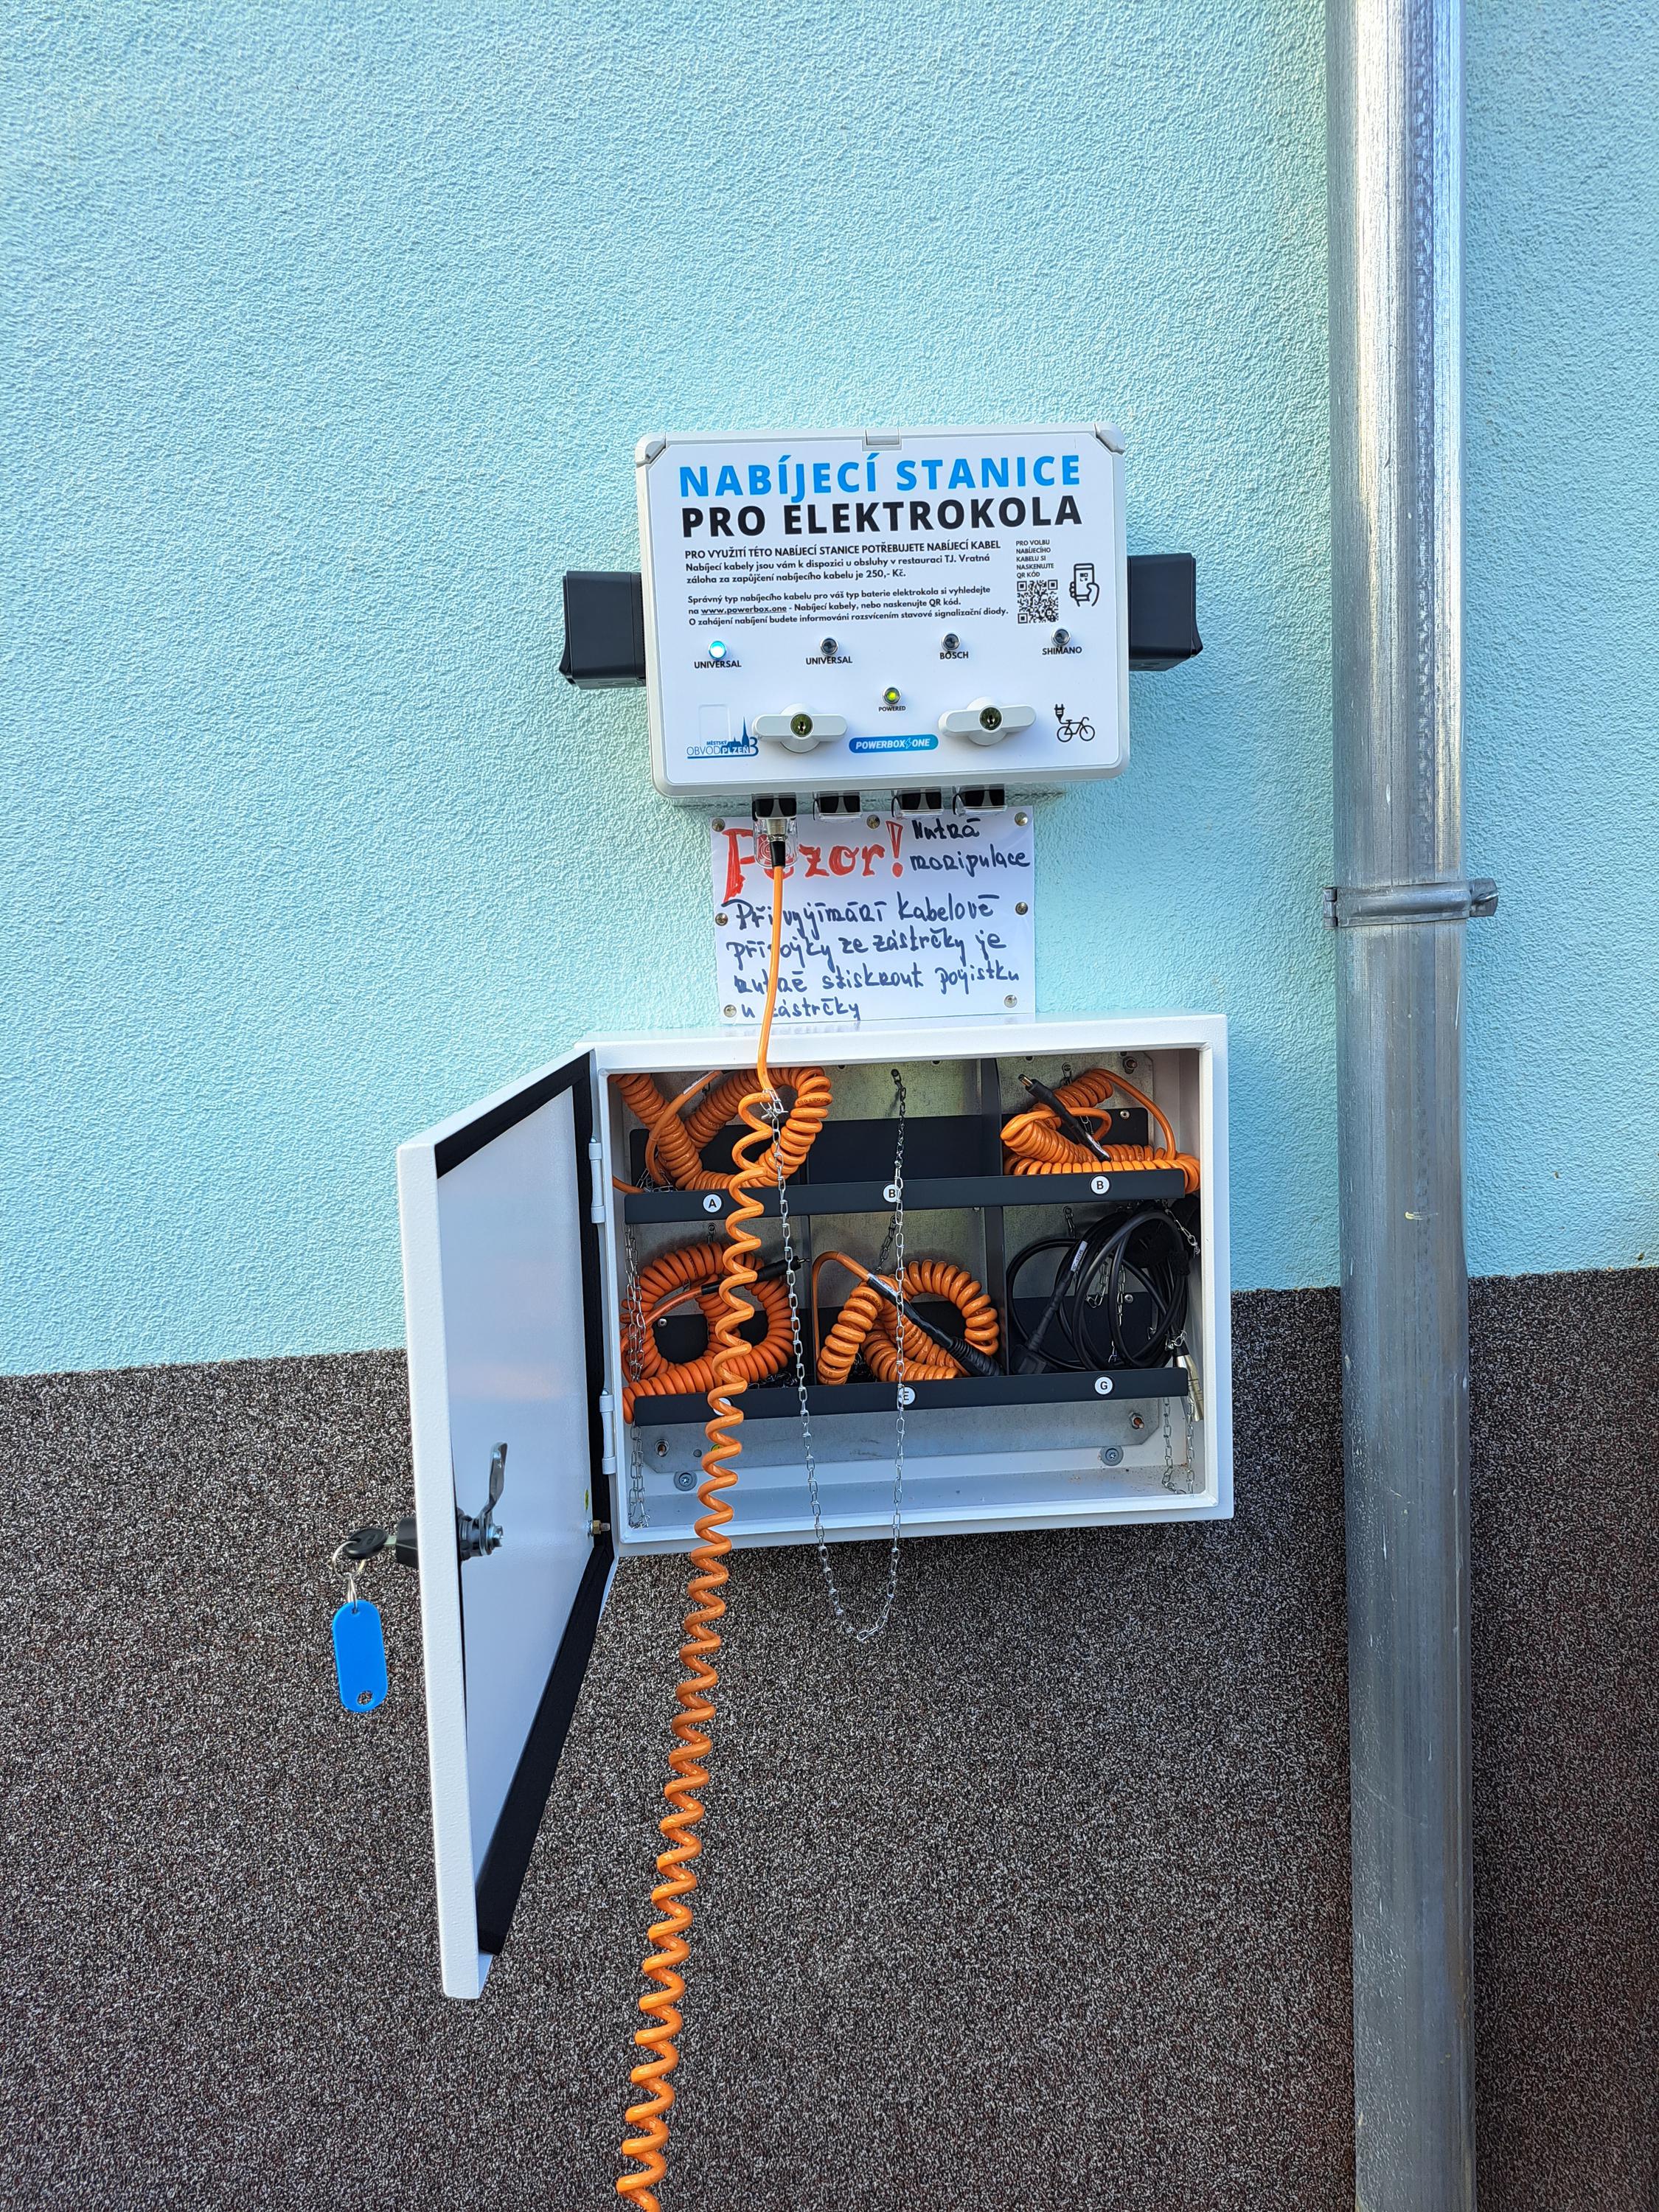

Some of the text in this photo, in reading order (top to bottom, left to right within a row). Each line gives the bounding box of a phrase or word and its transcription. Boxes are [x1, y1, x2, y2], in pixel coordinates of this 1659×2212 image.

[679, 453, 1080, 503] NABÍJECÍ STANICE
[682, 495, 1082, 538] PRO ELEKTROKOLA
[685, 540, 1001, 559] PRO VYUŽITÍ TÉTO NABÍJECÍ STANICE POTŘEBUJETE NABÍJECÍ KABEL
[686, 563, 722, 573] Nabíjecí
[724, 562, 754, 572] kabely
[756, 562, 774, 571] jsou
[776, 560, 796, 568] vám
[799, 560, 804, 568] k
[806, 559, 844, 569] dispozici
[854, 557, 888, 567] obsluhy
[898, 556, 942, 565] restauraci
[959, 554, 990, 563] Vratná
[686, 575, 717, 584] záloha
[732, 574, 774, 585] zapůjčení
[776, 572, 821, 582] nabíjecího
[824, 571, 854, 580] kabelu
[855, 571, 863, 580] je
[866, 570, 890, 580] 250,-
[892, 568, 906, 577] Kč.
[688, 596, 723, 605] Správný
[725, 596, 738, 604] typ
[740, 594, 782, 603] nabíjecího
[784, 592, 812, 601] kabelu
[813, 594, 828, 602] pro
[846, 591, 860, 600] typ
[861, 590, 890, 598] baterie
[892, 588, 939, 597] elektrokola
[949, 586, 990, 596] vyhledejte
[700, 605, 787, 615] www.powerbox.one
[794, 603, 827, 613] Nabíjecí
[830, 602, 859, 611] kabely,
[861, 601, 881, 609] nebo
[883, 599, 927, 608] naskenujte
[698, 617, 733, 627] zahájení
[735, 616, 768, 625] nabíjení
[769, 615, 797, 624] budete
[799, 613, 849, 622] informováni
[851, 611, 899, 620] rozsvícením
[901, 611, 933, 619] stavové
[934, 608, 981, 618] signalizační
[984, 608, 1009, 616] diody.
[939, 651, 969, 660] BOSCH
[1042, 646, 1082, 655] SHIMANO
[694, 660, 742, 669] UNIVERSAL
[806, 655, 852, 665] UNIVERSAL
[686, 746, 720, 756] OBVOD
[723, 745, 749, 754] PLZEŇ
[855, 738, 931, 750] POWERBOX ONE
[909, 844, 1031, 877] manipulace
[721, 898, 773, 930] Při
[897, 891, 1000, 922] kabelové
[726, 925, 1006, 973] příojky ze zástrčky je
[822, 961, 924, 990] stisknout
[935, 959, 1020, 995] pojistku
[741, 996, 861, 1021] u ástrčky
[1096, 1180, 1104, 1189] B
[888, 1189, 896, 1198] B
[708, 1198, 717, 1208] A
[1100, 1381, 1108, 1390] G
[902, 1391, 909, 1400] E
